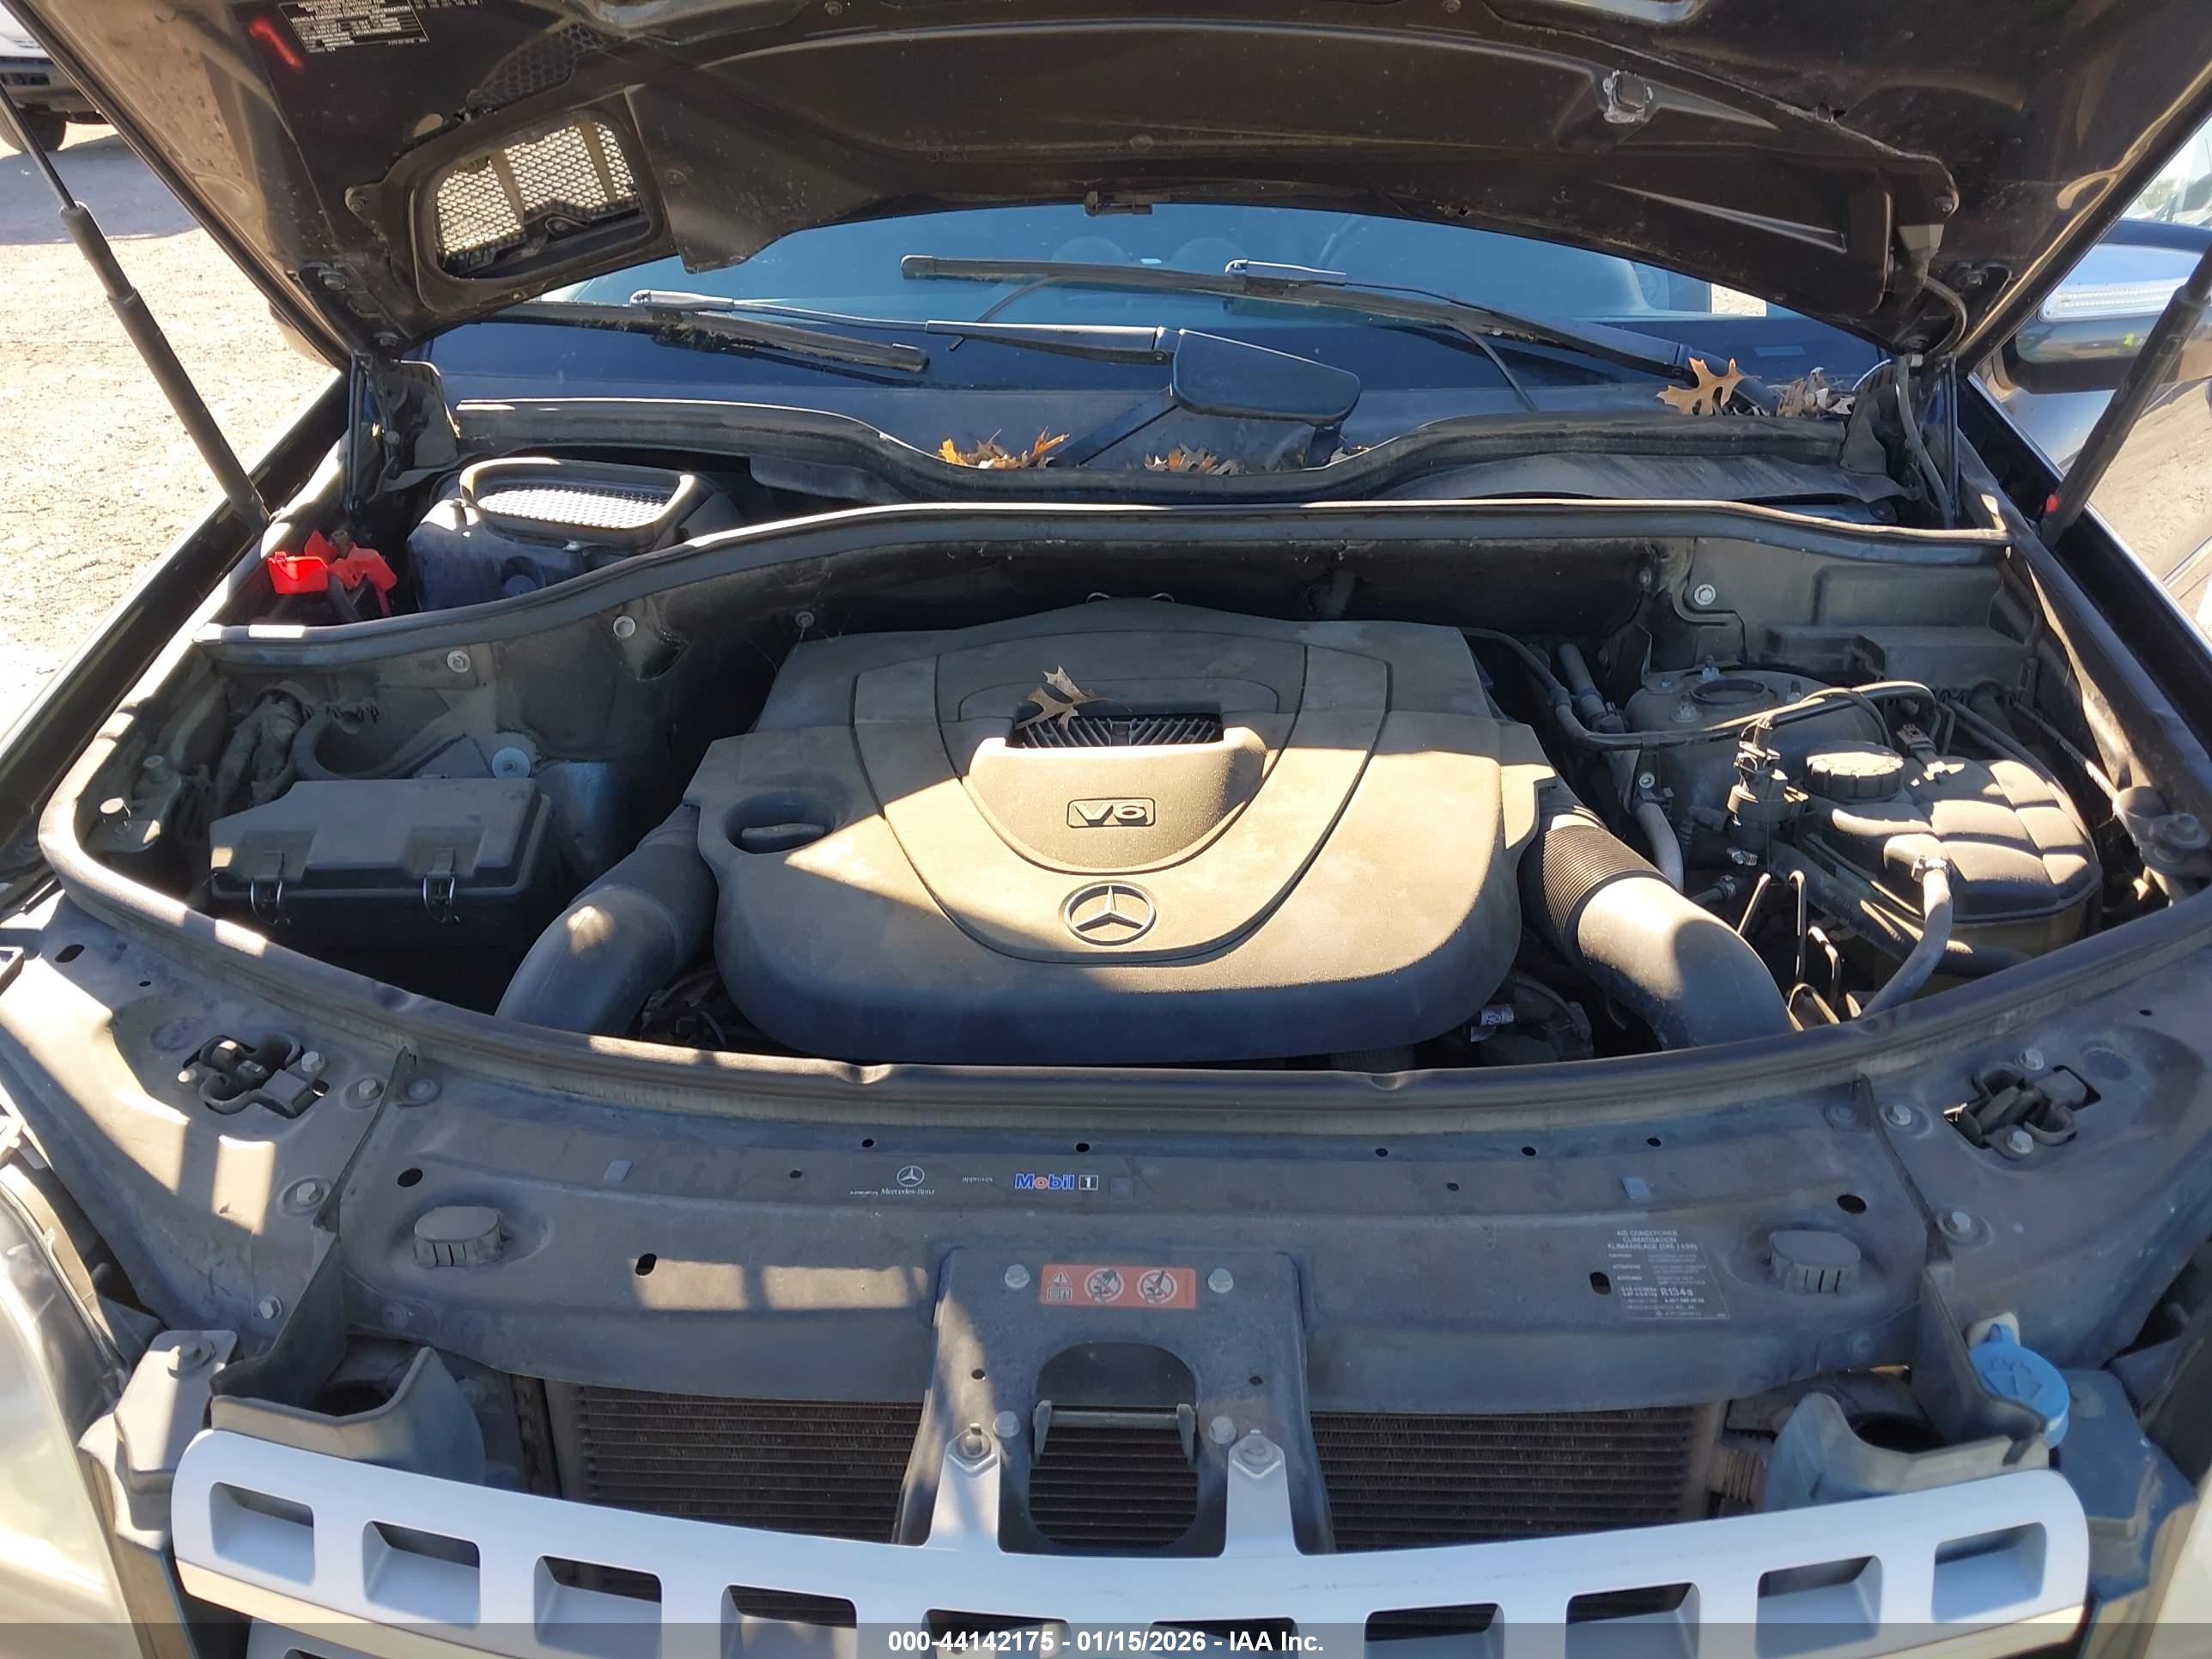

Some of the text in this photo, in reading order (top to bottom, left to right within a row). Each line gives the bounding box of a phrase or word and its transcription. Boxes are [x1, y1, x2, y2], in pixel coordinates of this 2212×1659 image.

[1073, 801, 1147, 824] V6
[1015, 1173, 1075, 1190] Mobil
[880, 1188, 936, 1196] Mercedes-Benz
[1660, 1287, 1694, 1297] R134a
